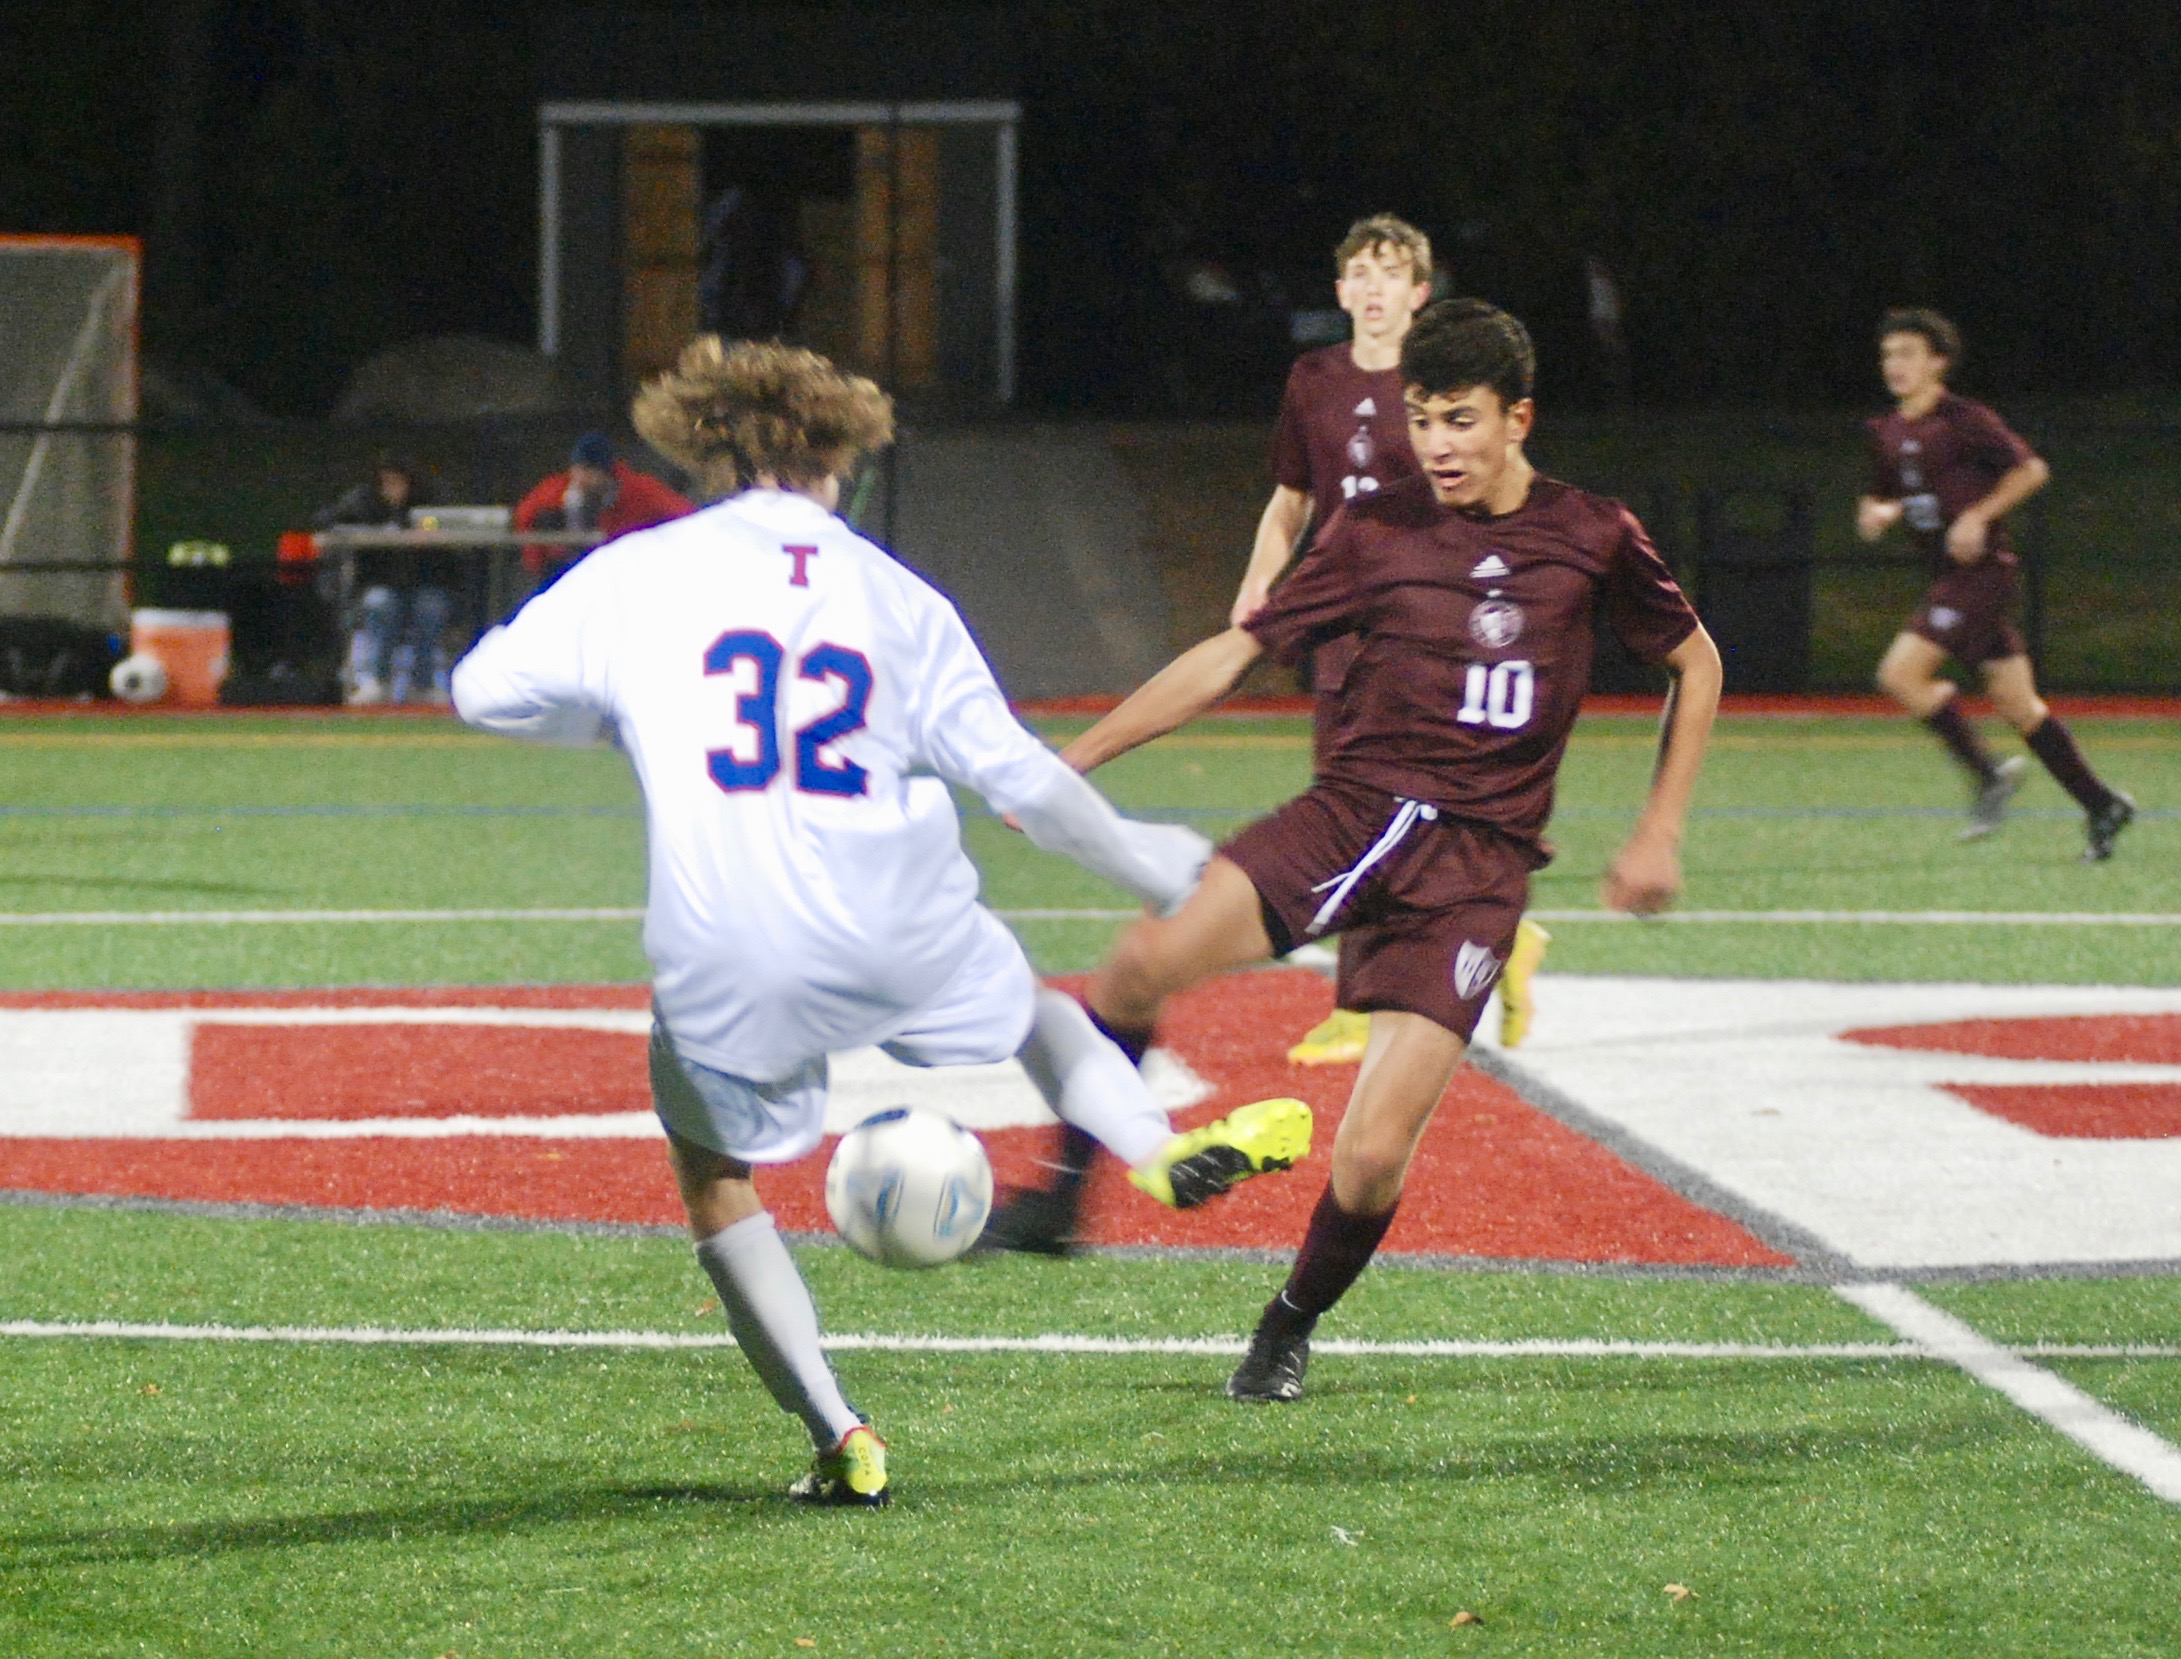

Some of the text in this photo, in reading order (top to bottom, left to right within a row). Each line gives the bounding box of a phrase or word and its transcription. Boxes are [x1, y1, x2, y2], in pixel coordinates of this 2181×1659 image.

[782, 544, 819, 588] T
[703, 628, 874, 797] 32
[1457, 660, 1534, 729] 10
